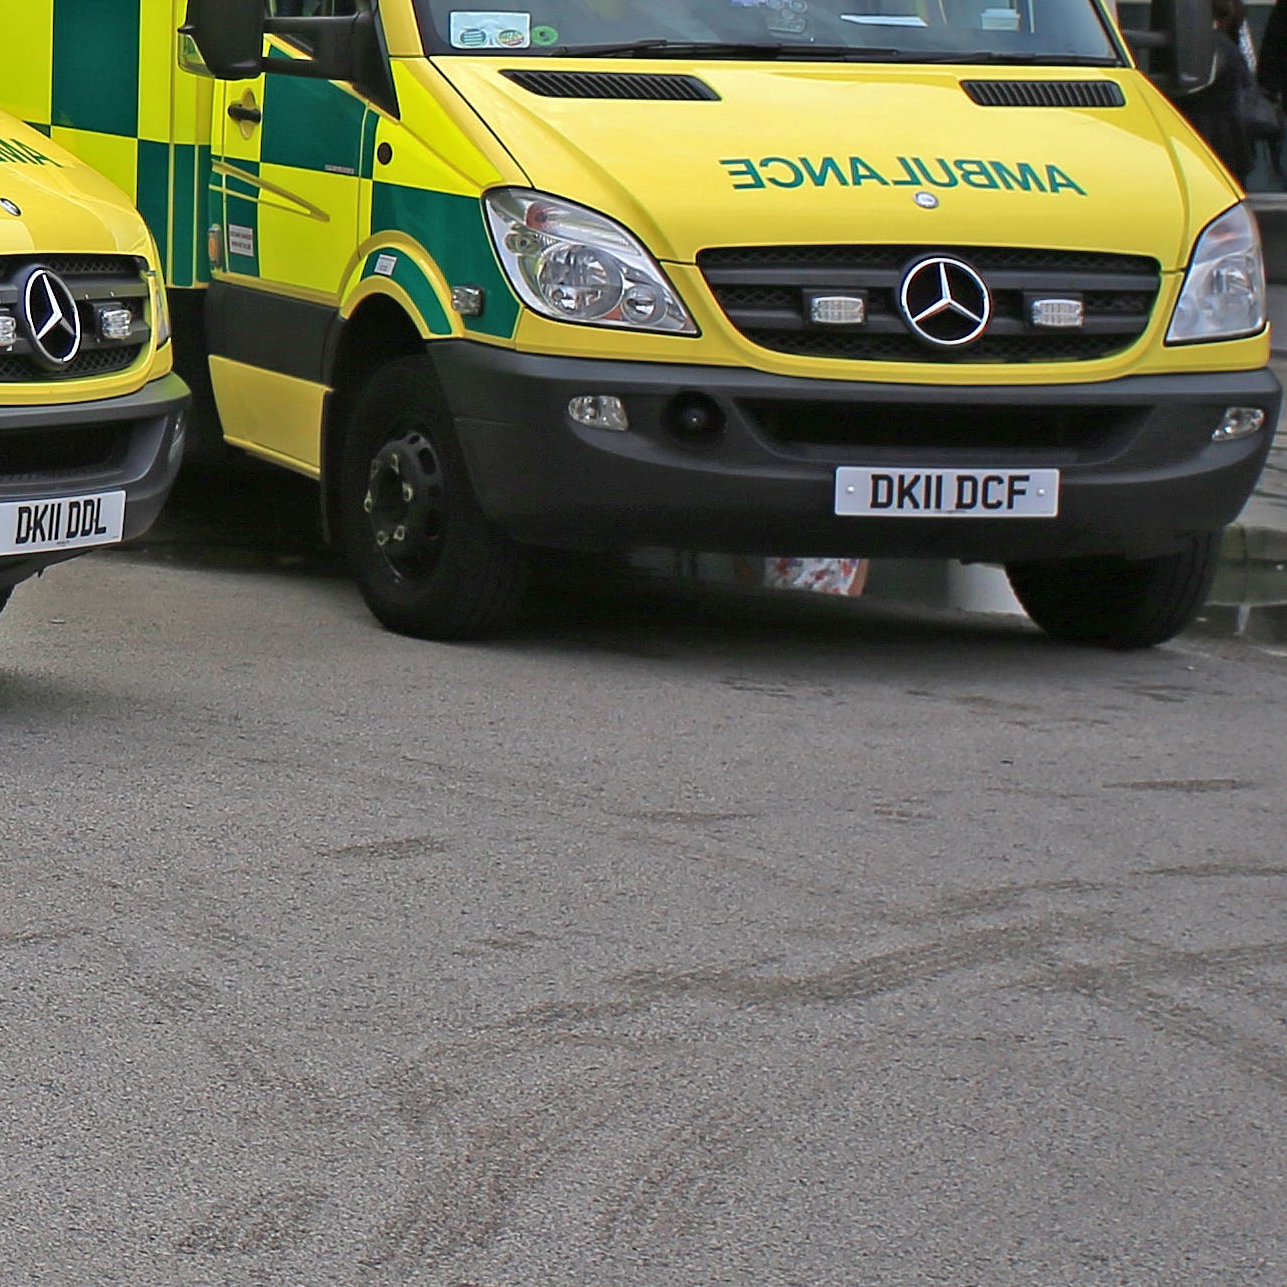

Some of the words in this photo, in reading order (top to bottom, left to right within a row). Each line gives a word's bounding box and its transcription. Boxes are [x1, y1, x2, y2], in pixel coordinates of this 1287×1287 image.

[870, 474, 943, 509] DK11
[955, 475, 1030, 510] DCF
[15, 502, 62, 544] DK11
[66, 498, 107, 539] DDL
